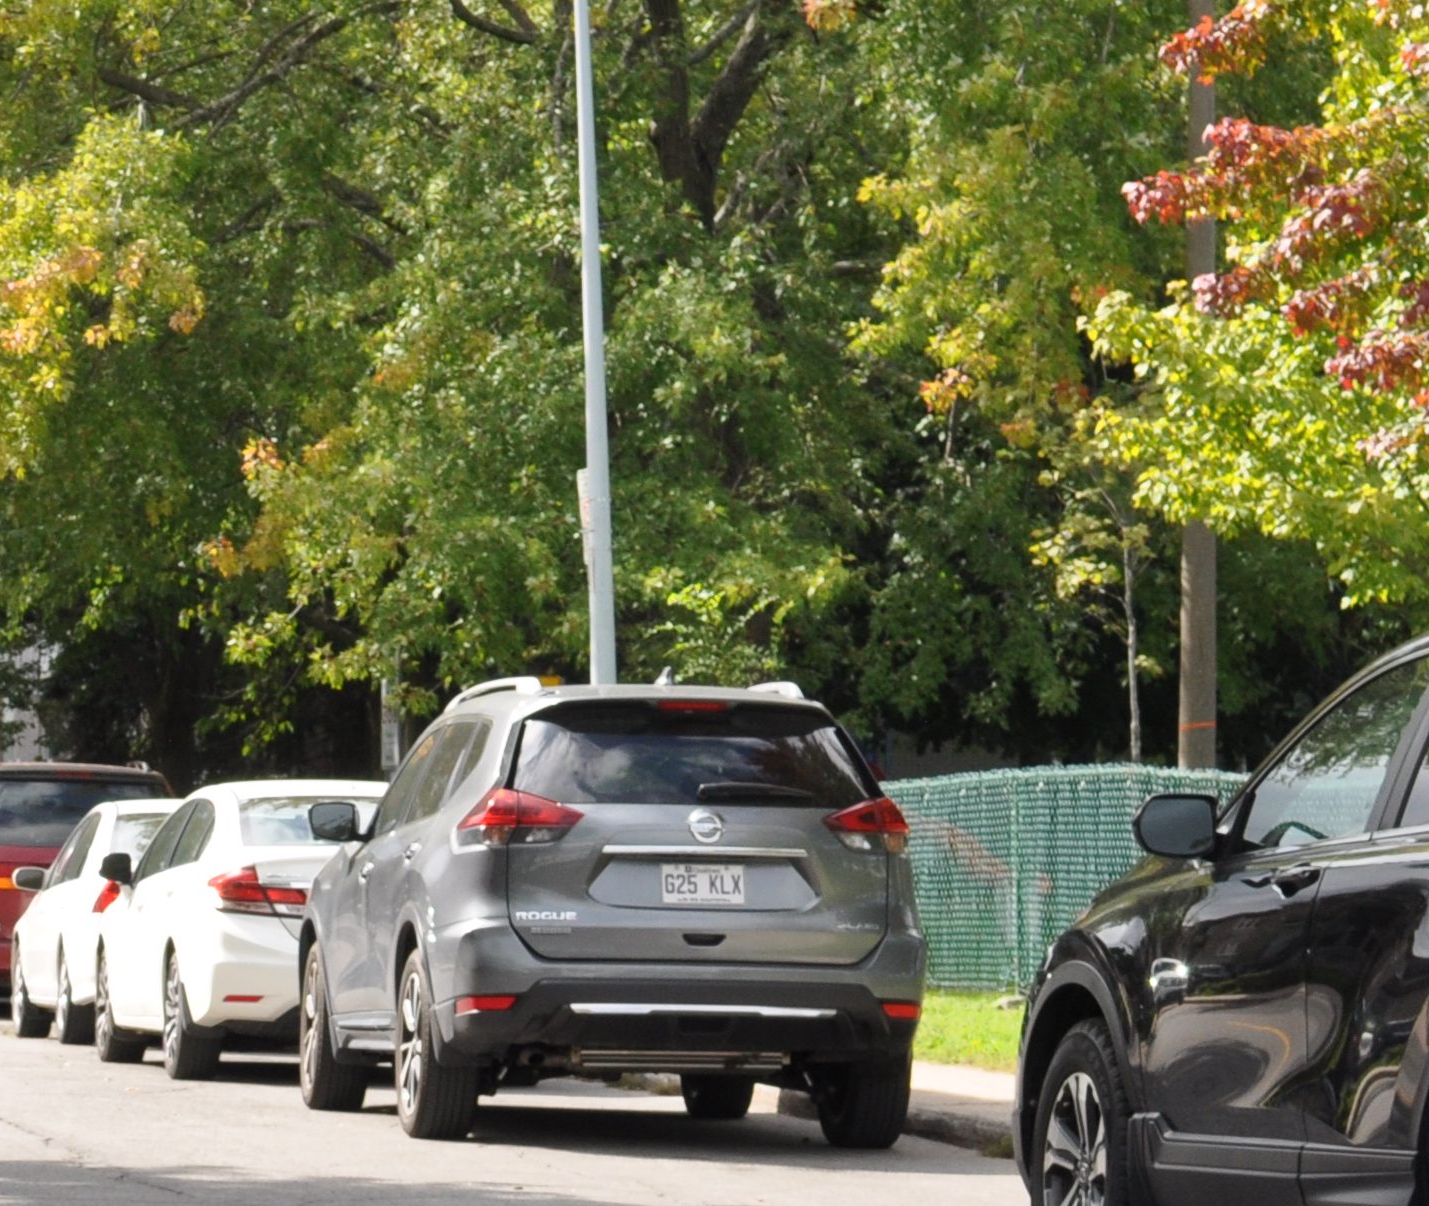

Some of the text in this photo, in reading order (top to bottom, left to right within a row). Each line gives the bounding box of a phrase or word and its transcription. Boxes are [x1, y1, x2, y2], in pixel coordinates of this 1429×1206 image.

[664, 873, 742, 895] G25 KLX
[515, 911, 578, 921] ROGUE
